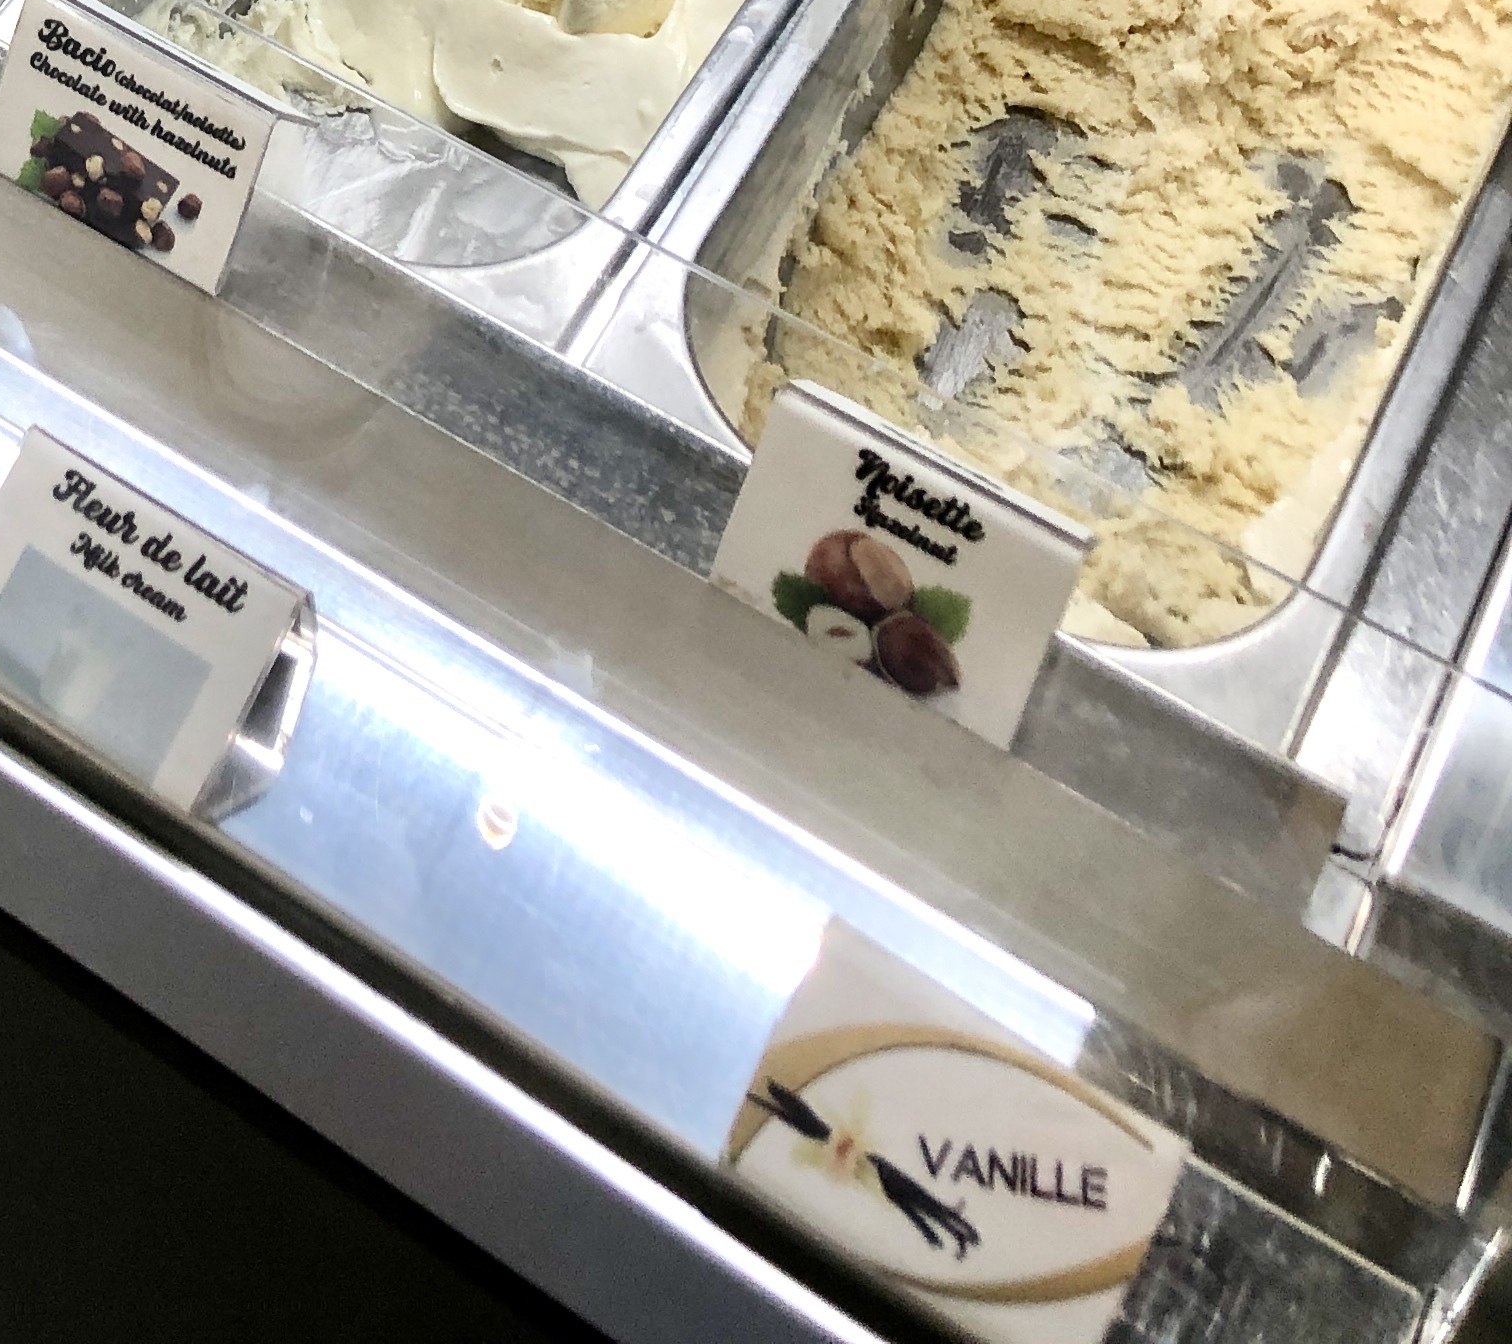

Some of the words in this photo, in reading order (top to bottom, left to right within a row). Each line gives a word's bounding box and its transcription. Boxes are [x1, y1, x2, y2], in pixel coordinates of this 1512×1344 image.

[37, 18, 117, 78] Bacio
[29, 50, 108, 108] Chocolate
[107, 98, 151, 132] with
[149, 117, 239, 181] hazelnuts
[854, 448, 986, 542] Noisette
[51, 468, 141, 546] Fleur
[140, 530, 184, 574] de
[183, 553, 249, 614] lait
[120, 570, 189, 623] cream
[917, 1132, 1110, 1212] VANILLE
